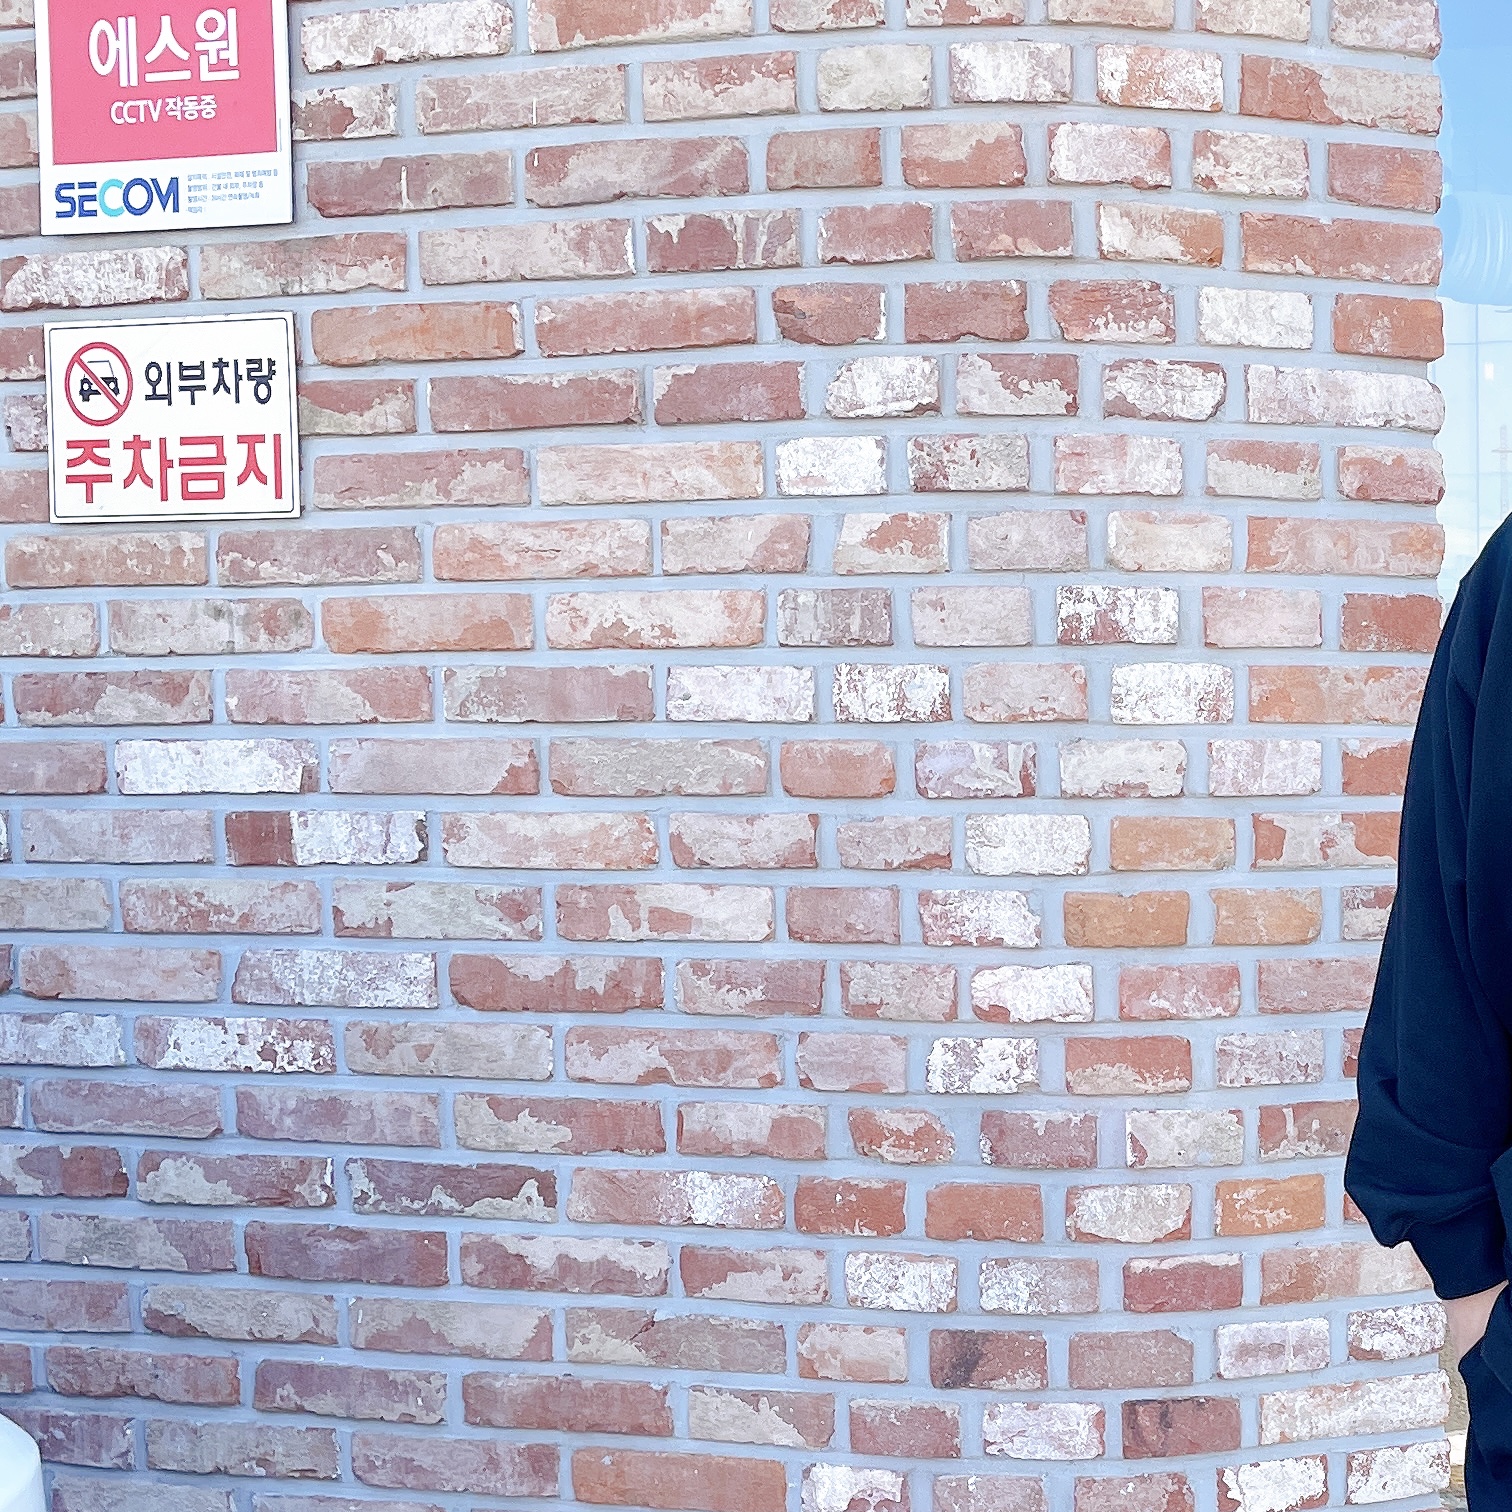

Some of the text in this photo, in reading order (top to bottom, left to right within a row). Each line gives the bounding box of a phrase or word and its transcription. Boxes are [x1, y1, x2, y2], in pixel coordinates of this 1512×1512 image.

[88, 7, 240, 88] 에스원
[54, 176, 180, 218] SECOM
[144, 357, 277, 406] 외부차량
[65, 433, 283, 504] 주차금지
